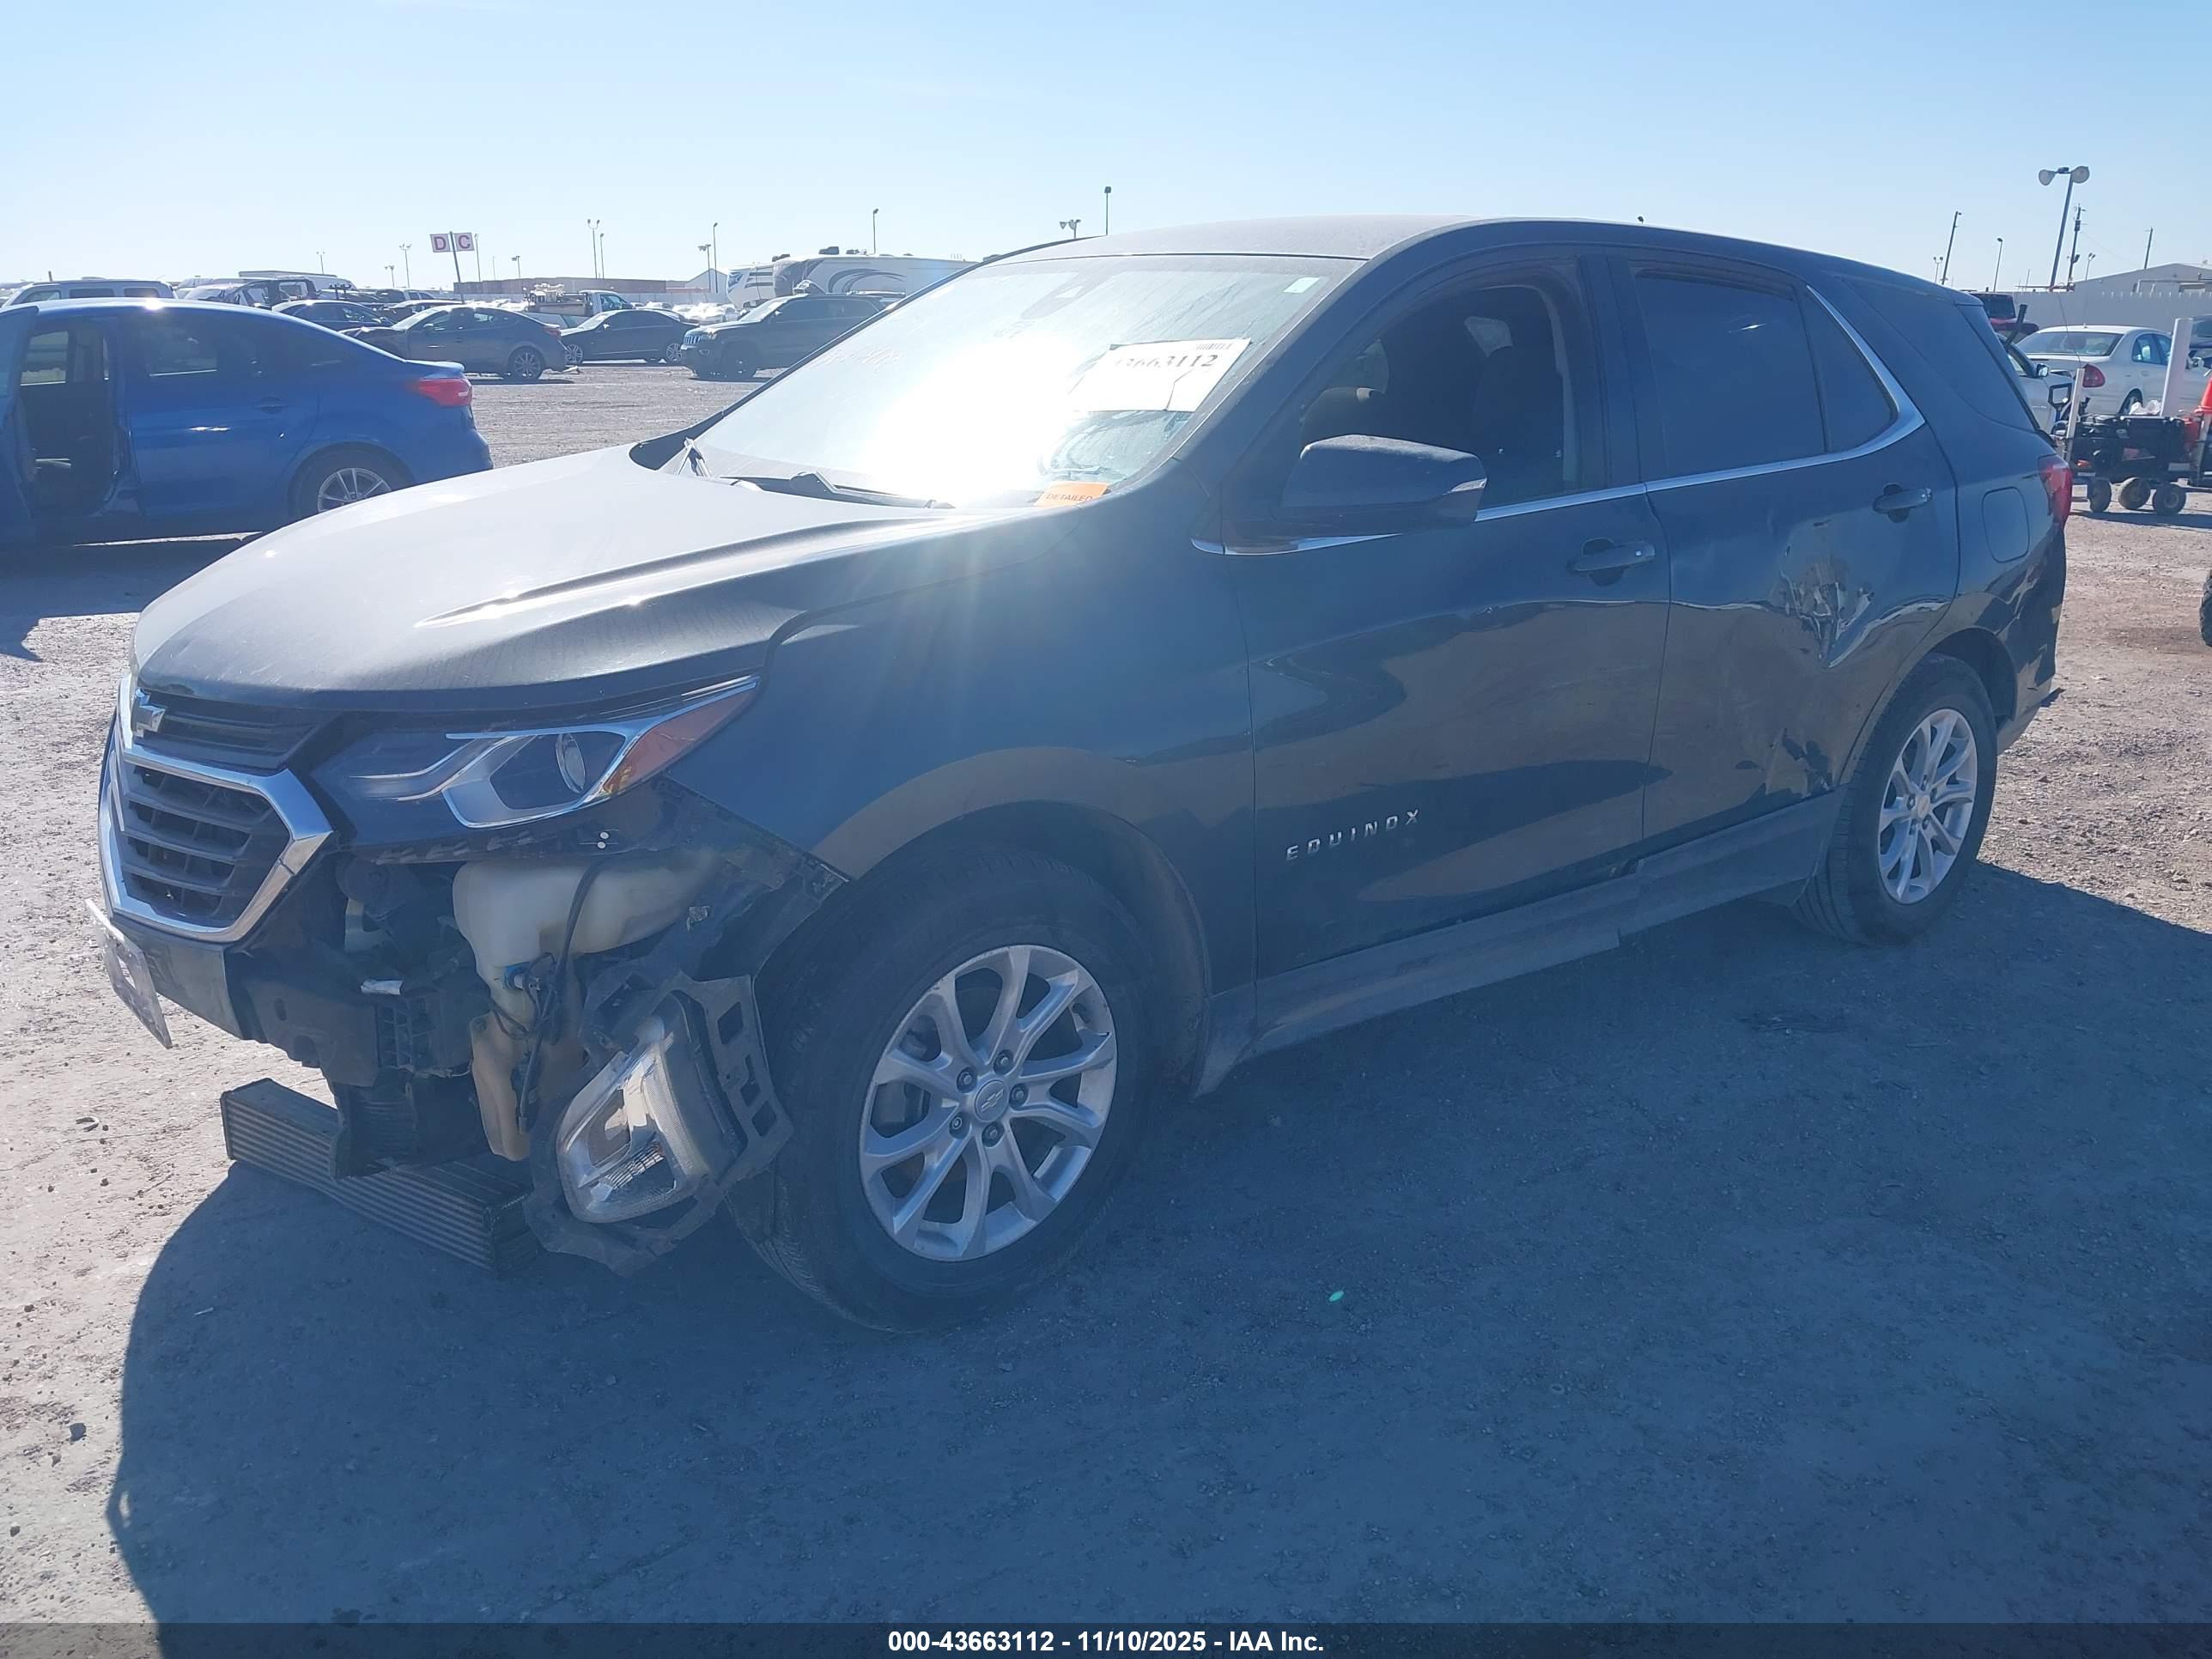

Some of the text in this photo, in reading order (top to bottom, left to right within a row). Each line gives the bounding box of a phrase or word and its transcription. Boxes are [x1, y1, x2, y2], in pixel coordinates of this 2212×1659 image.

[434, 234, 471, 250] D C
[1045, 493, 1093, 502] DETAILED
[1285, 809, 1419, 861] EQUINOX
